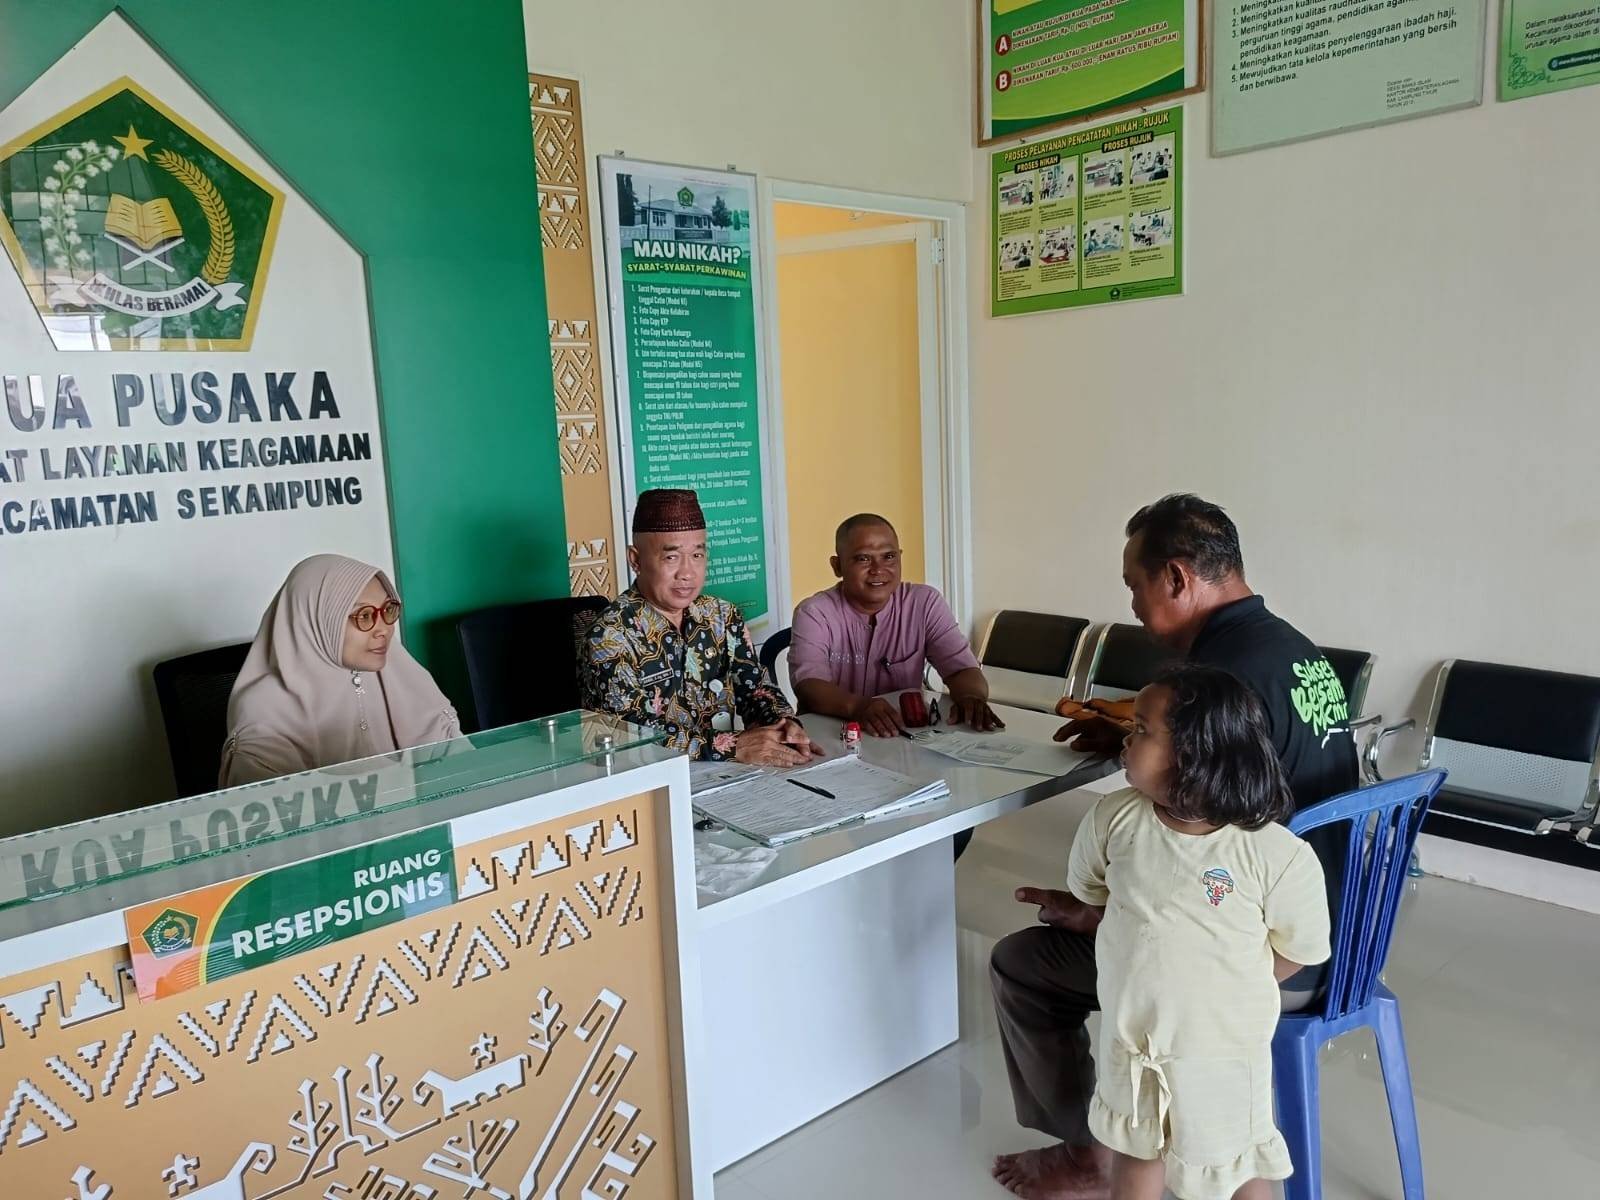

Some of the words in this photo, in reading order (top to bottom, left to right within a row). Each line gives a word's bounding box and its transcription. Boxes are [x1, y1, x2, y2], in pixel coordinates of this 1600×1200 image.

[1240, 31, 1279, 49] perguruan
[1281, 25, 1303, 36] tinggi
[1337, 3, 1384, 22] pendidikan
[1241, 4, 1293, 24] Meningkatkan
[1241, 16, 1293, 36] Meningkatkan
[1296, 6, 1326, 20] kualitas
[999, 36, 1008, 53] A
[1240, 50, 1292, 70] Meningkatkan
[1295, 42, 1325, 56] kualitas
[1328, 22, 1401, 49] penyelenggaraan
[1404, 13, 1434, 27] ibadah
[1240, 42, 1281, 60] pendidikan
[1240, 63, 1287, 82] Mewujudkan
[1289, 58, 1304, 69] tata
[1306, 52, 1329, 64] kelola
[1332, 35, 1400, 58] kepemerintahan
[1402, 29, 1425, 42] yang
[1428, 20, 1456, 34] bersih
[1000, 73, 1008, 90] B
[1240, 83, 1254, 92] dan
[1004, 147, 1028, 162] PROSES
[1030, 138, 1067, 156] PELAYANAN
[1068, 129, 1111, 148] PENCATATAN
[1114, 122, 1138, 135] NIKAH
[1143, 114, 1169, 129] RUJUK
[1104, 138, 1128, 151] PROSES
[1130, 133, 1152, 146] RUJUK
[1016, 160, 1039, 173] PROSES
[1039, 156, 1059, 168] NIKAH
[632, 240, 676, 258] MAU
[678, 243, 741, 265] NIKAH?
[627, 263, 695, 273] SYARAT-SYARAT
[696, 266, 747, 280] PERKAWINAN
[147, 281, 212, 311] BERAMAL
[113, 370, 341, 428] PUSAKA
[40, 441, 188, 481] LAYANAN
[197, 432, 373, 472] KEAGAMAAN
[0, 490, 159, 536] CAMATAN
[177, 476, 363, 520] SEKAMPUNG
[354, 848, 441, 888] RUANG
[231, 871, 445, 959] RESEPSIONIS
